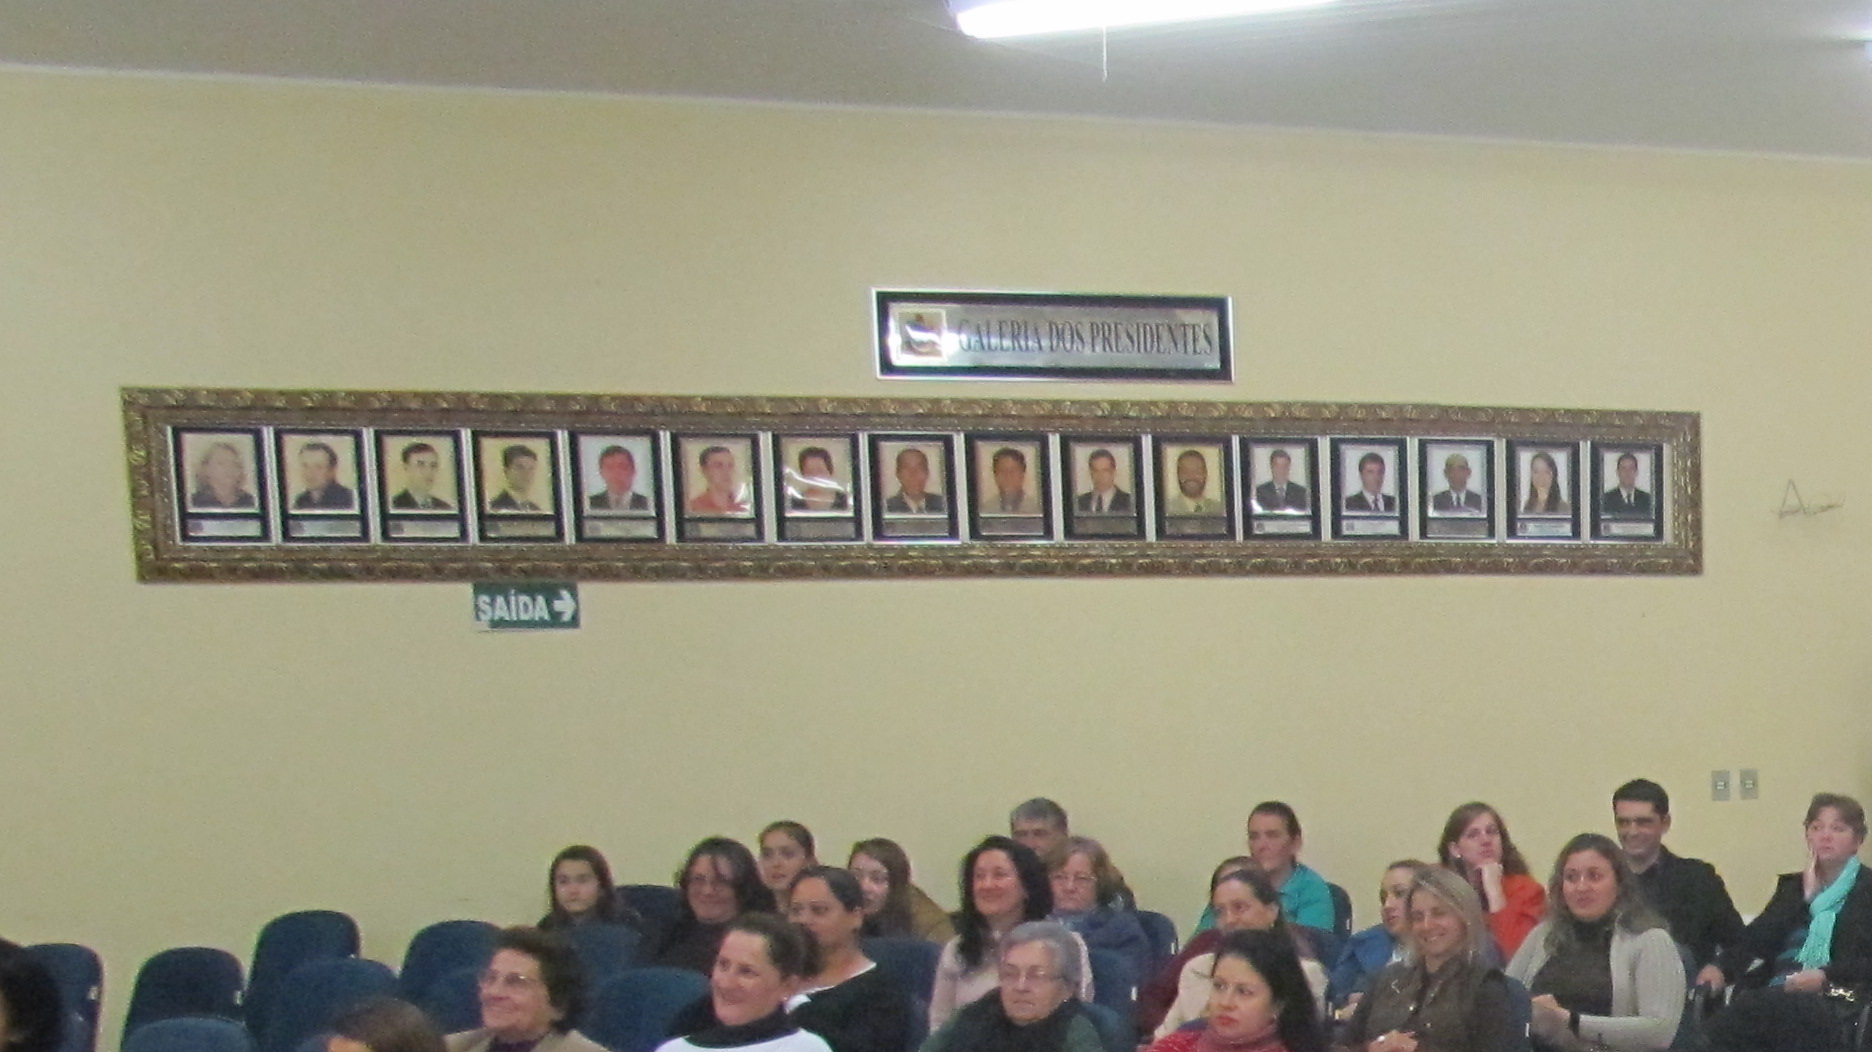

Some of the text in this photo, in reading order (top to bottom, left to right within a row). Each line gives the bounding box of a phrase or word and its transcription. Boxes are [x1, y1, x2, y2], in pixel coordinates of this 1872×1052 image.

[957, 319, 1213, 356] GALERIA DOS PRESIDENTES
[476, 588, 551, 622] SAÍDA
